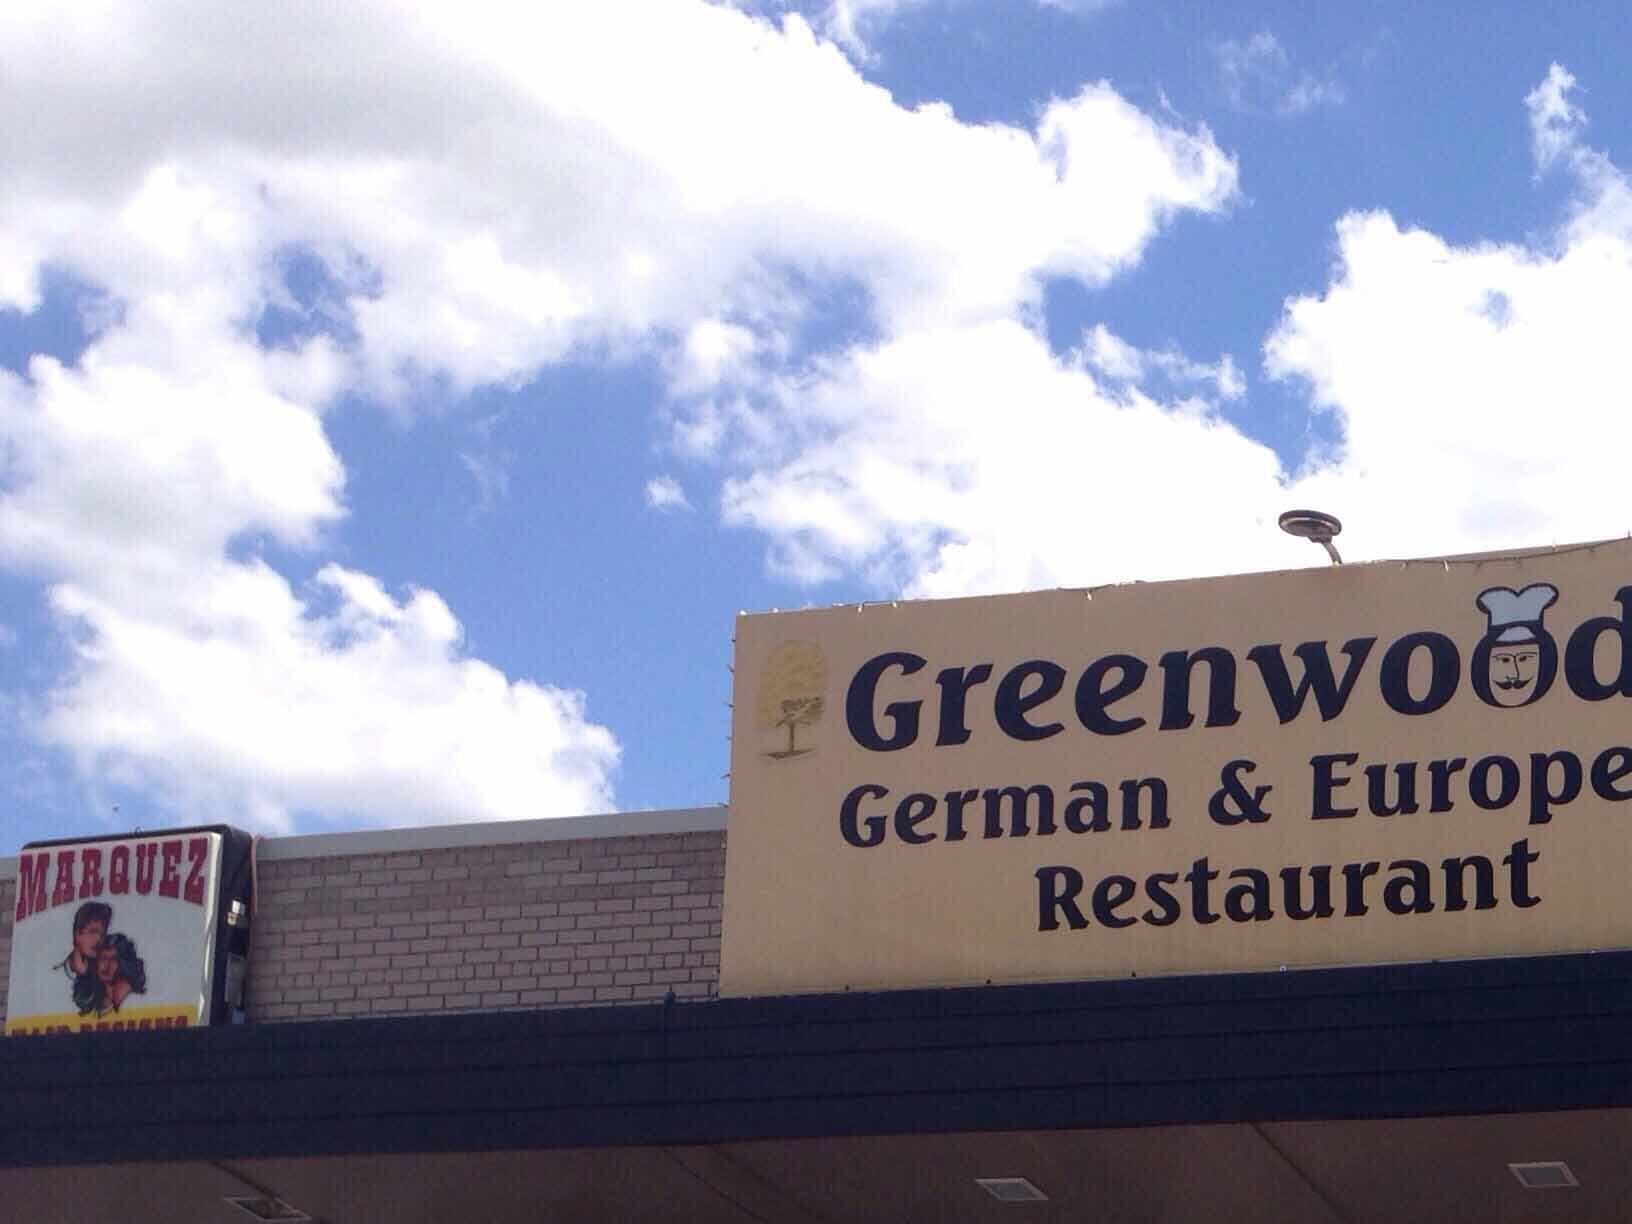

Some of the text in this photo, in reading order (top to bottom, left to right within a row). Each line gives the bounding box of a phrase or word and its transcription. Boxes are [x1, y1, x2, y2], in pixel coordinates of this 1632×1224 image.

[839, 775, 1171, 847] German
[1207, 758, 1272, 826] &
[16, 838, 208, 922] MARQUEZ
[1034, 838, 1541, 931] Restaurant
